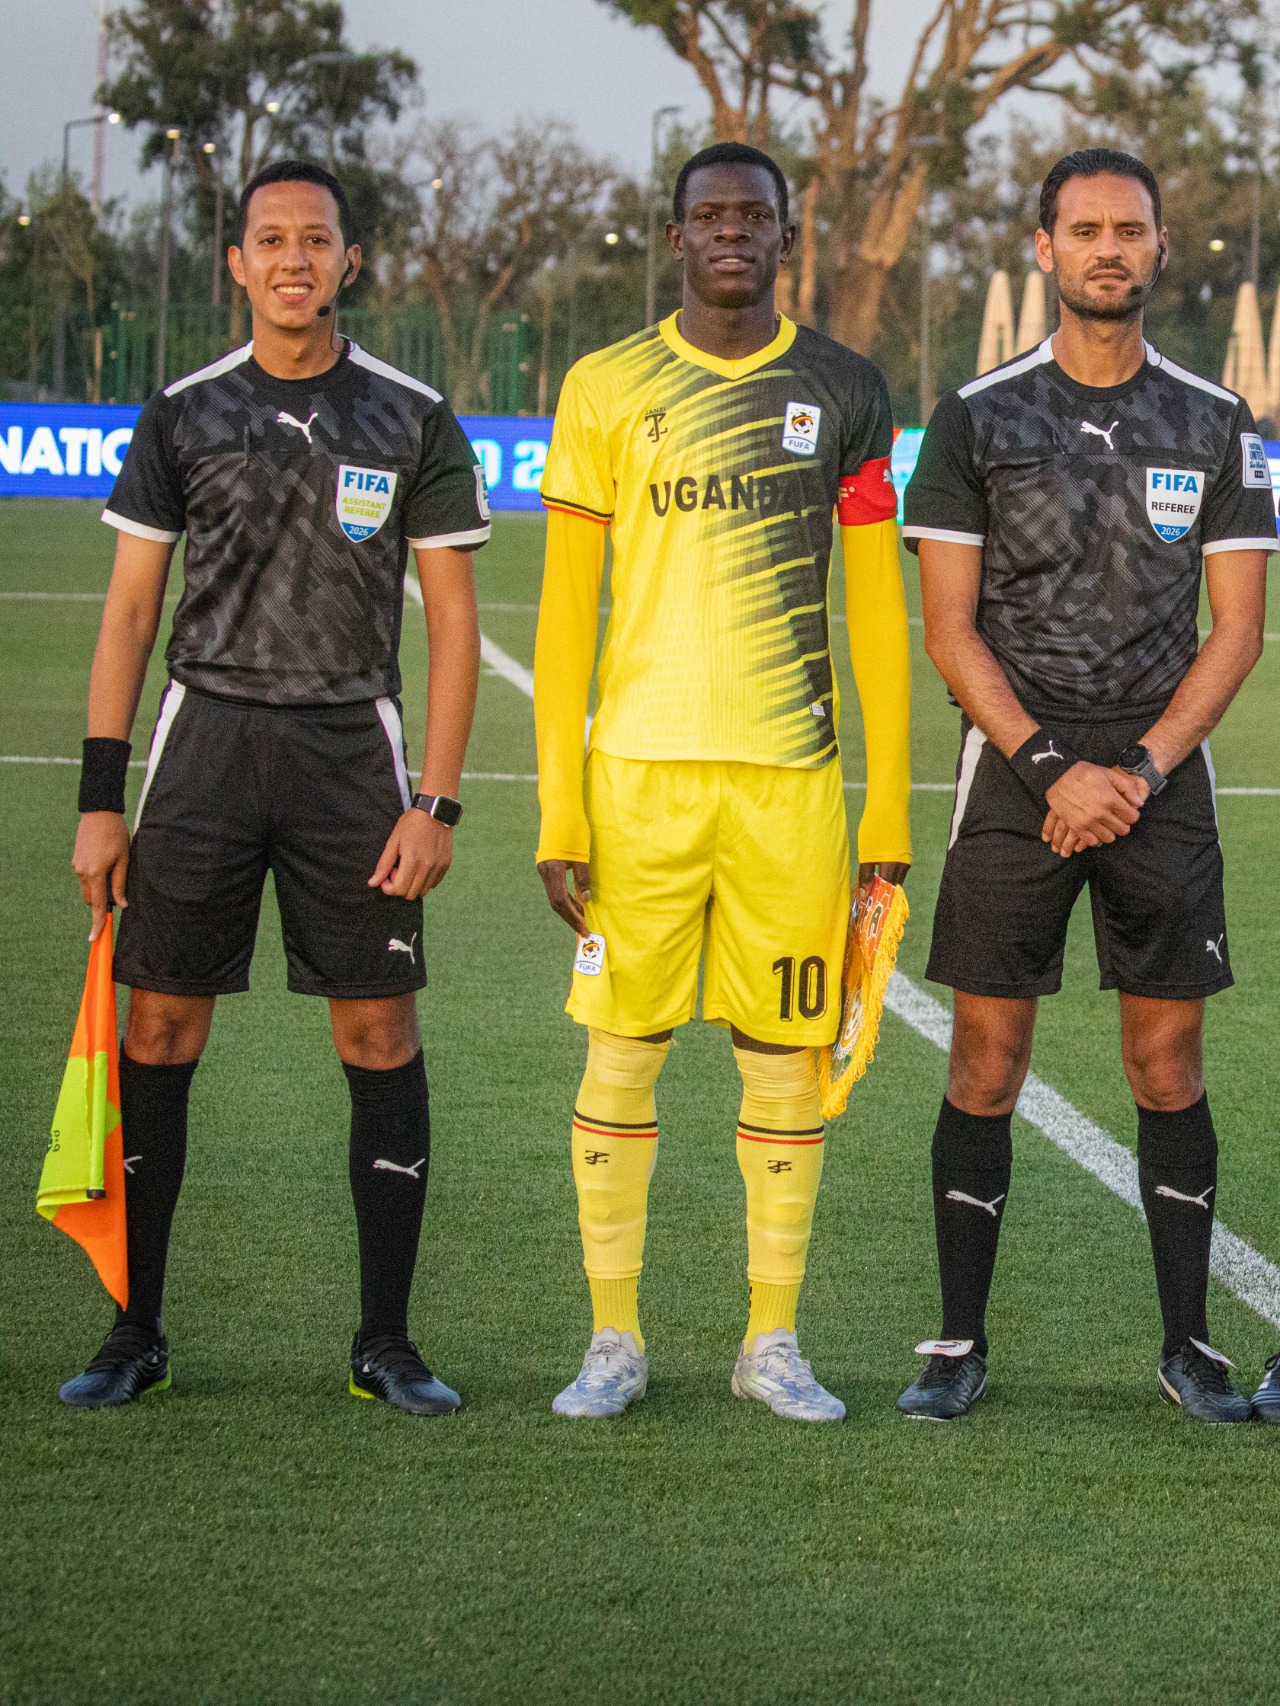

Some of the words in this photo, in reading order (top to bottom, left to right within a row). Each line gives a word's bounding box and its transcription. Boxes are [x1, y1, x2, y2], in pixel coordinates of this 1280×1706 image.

[788, 439, 810, 451] FUFA
[344, 471, 389, 494] FIFA
[1152, 473, 1198, 493] FIFA
[649, 474, 803, 518] UGAND
[342, 497, 387, 510] ASSISTANT
[1151, 501, 1196, 514] REFEREE
[344, 506, 381, 518] REFEREE
[349, 526, 369, 536] 2026
[1161, 527, 1180, 536] 2026
[579, 963, 596, 972] FUFA
[772, 955, 828, 1022] 10
